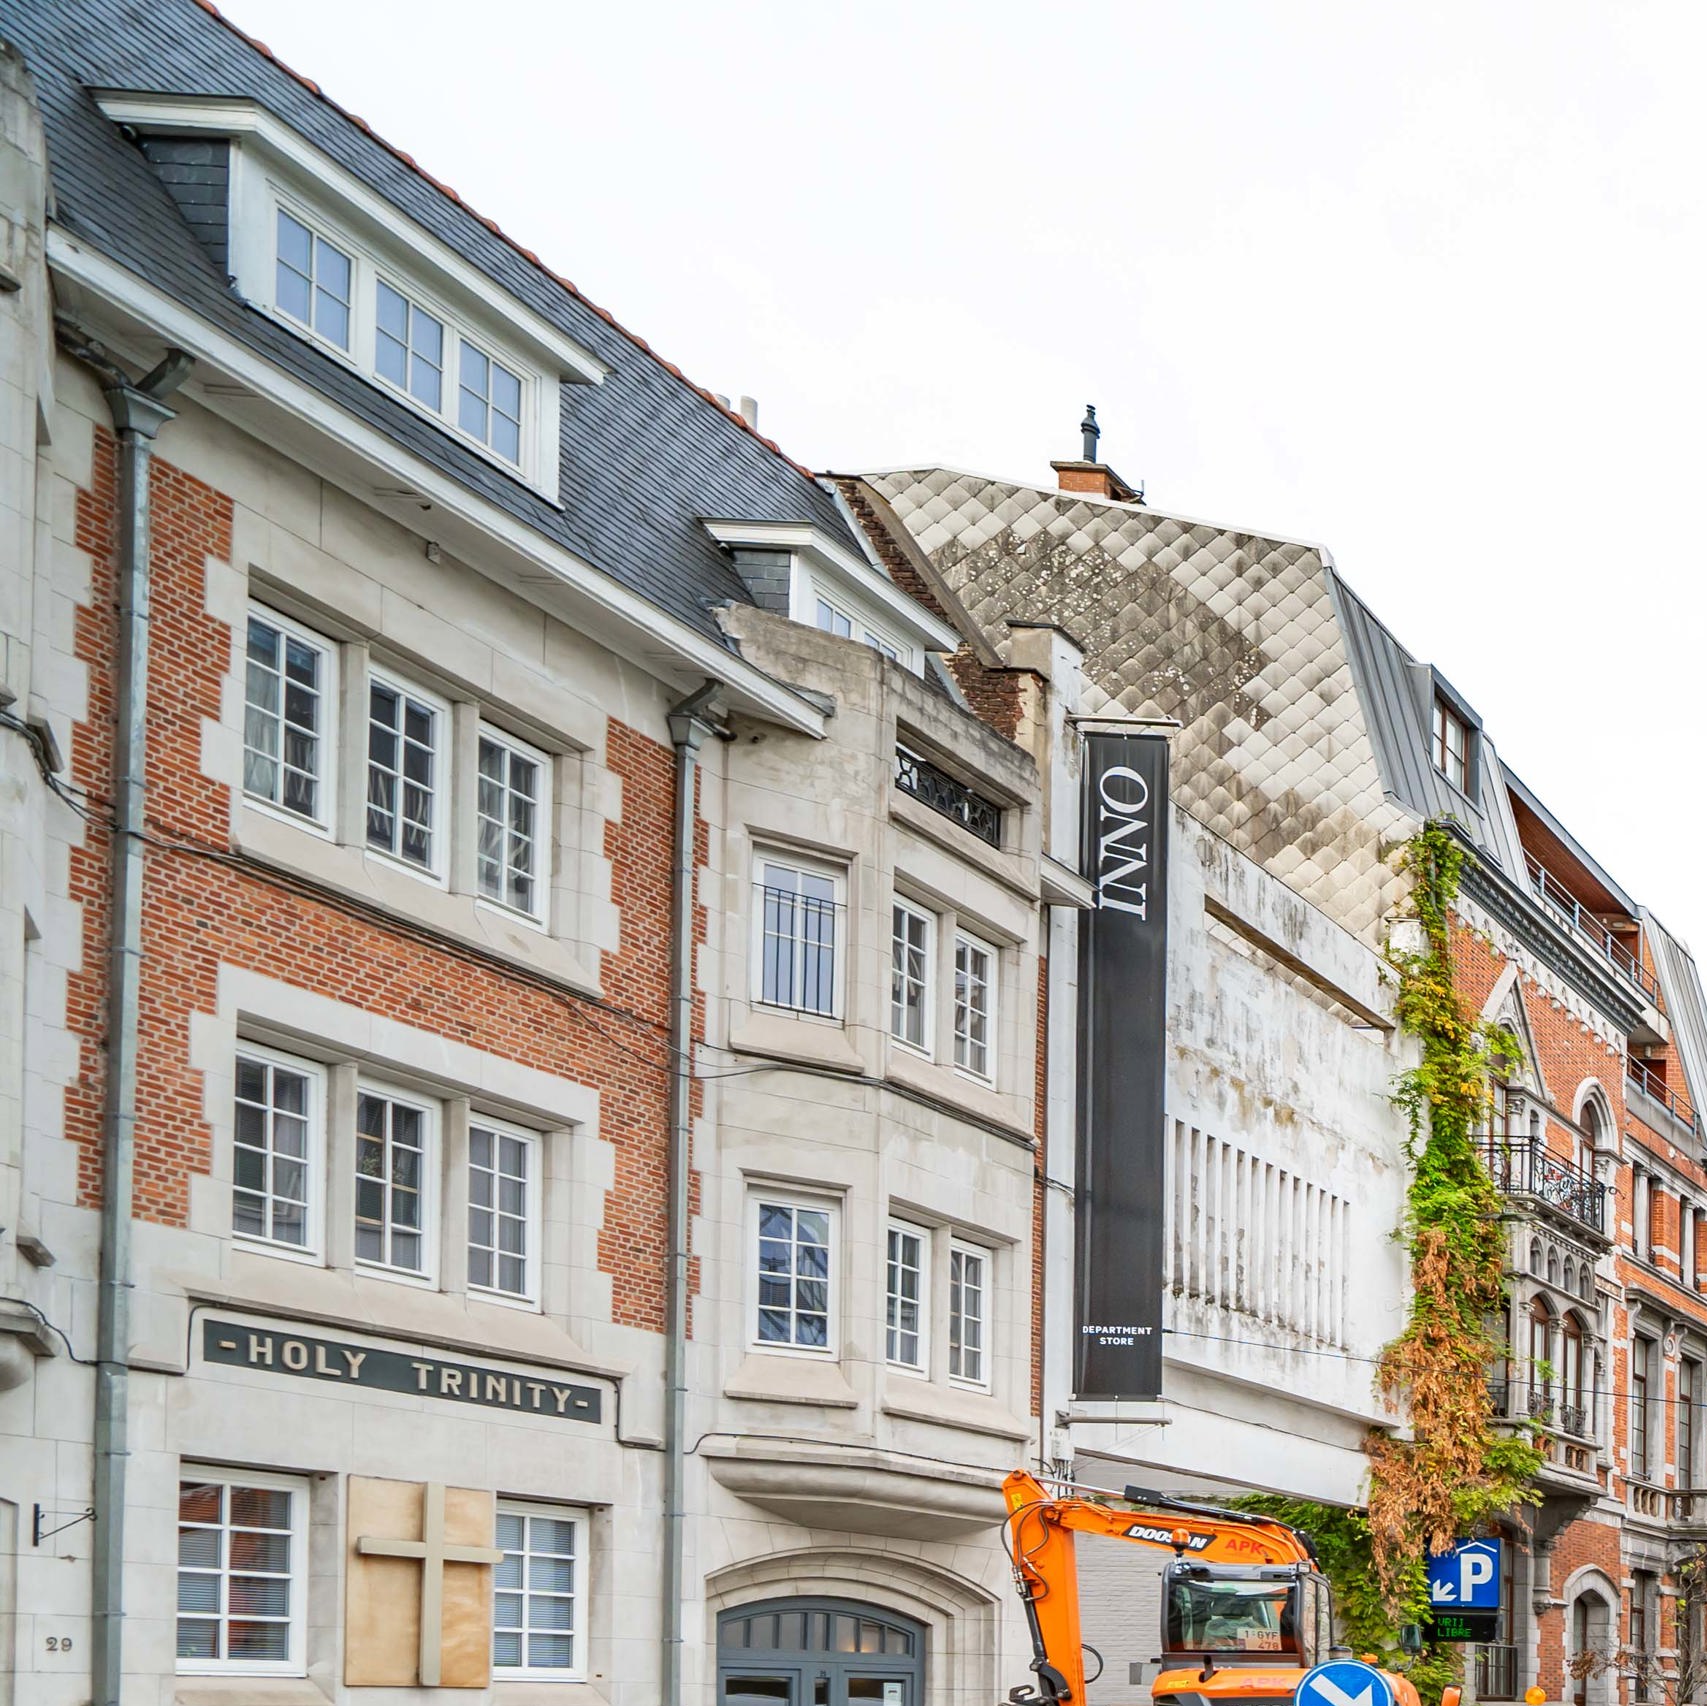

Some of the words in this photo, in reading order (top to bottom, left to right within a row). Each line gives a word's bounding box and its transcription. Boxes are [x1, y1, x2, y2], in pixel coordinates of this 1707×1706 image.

[1099, 766, 1148, 921] INNO
[1082, 1325, 1153, 1335] DEPARTMENT
[1099, 1336, 1134, 1346] STORE
[1128, 1525, 1208, 1549] DOON
[1460, 1553, 1493, 1602] P
[1437, 1617, 1464, 1627] VRIJ
[1437, 1628, 1472, 1637] LIBRE
[46, 1636, 73, 1652] 29
